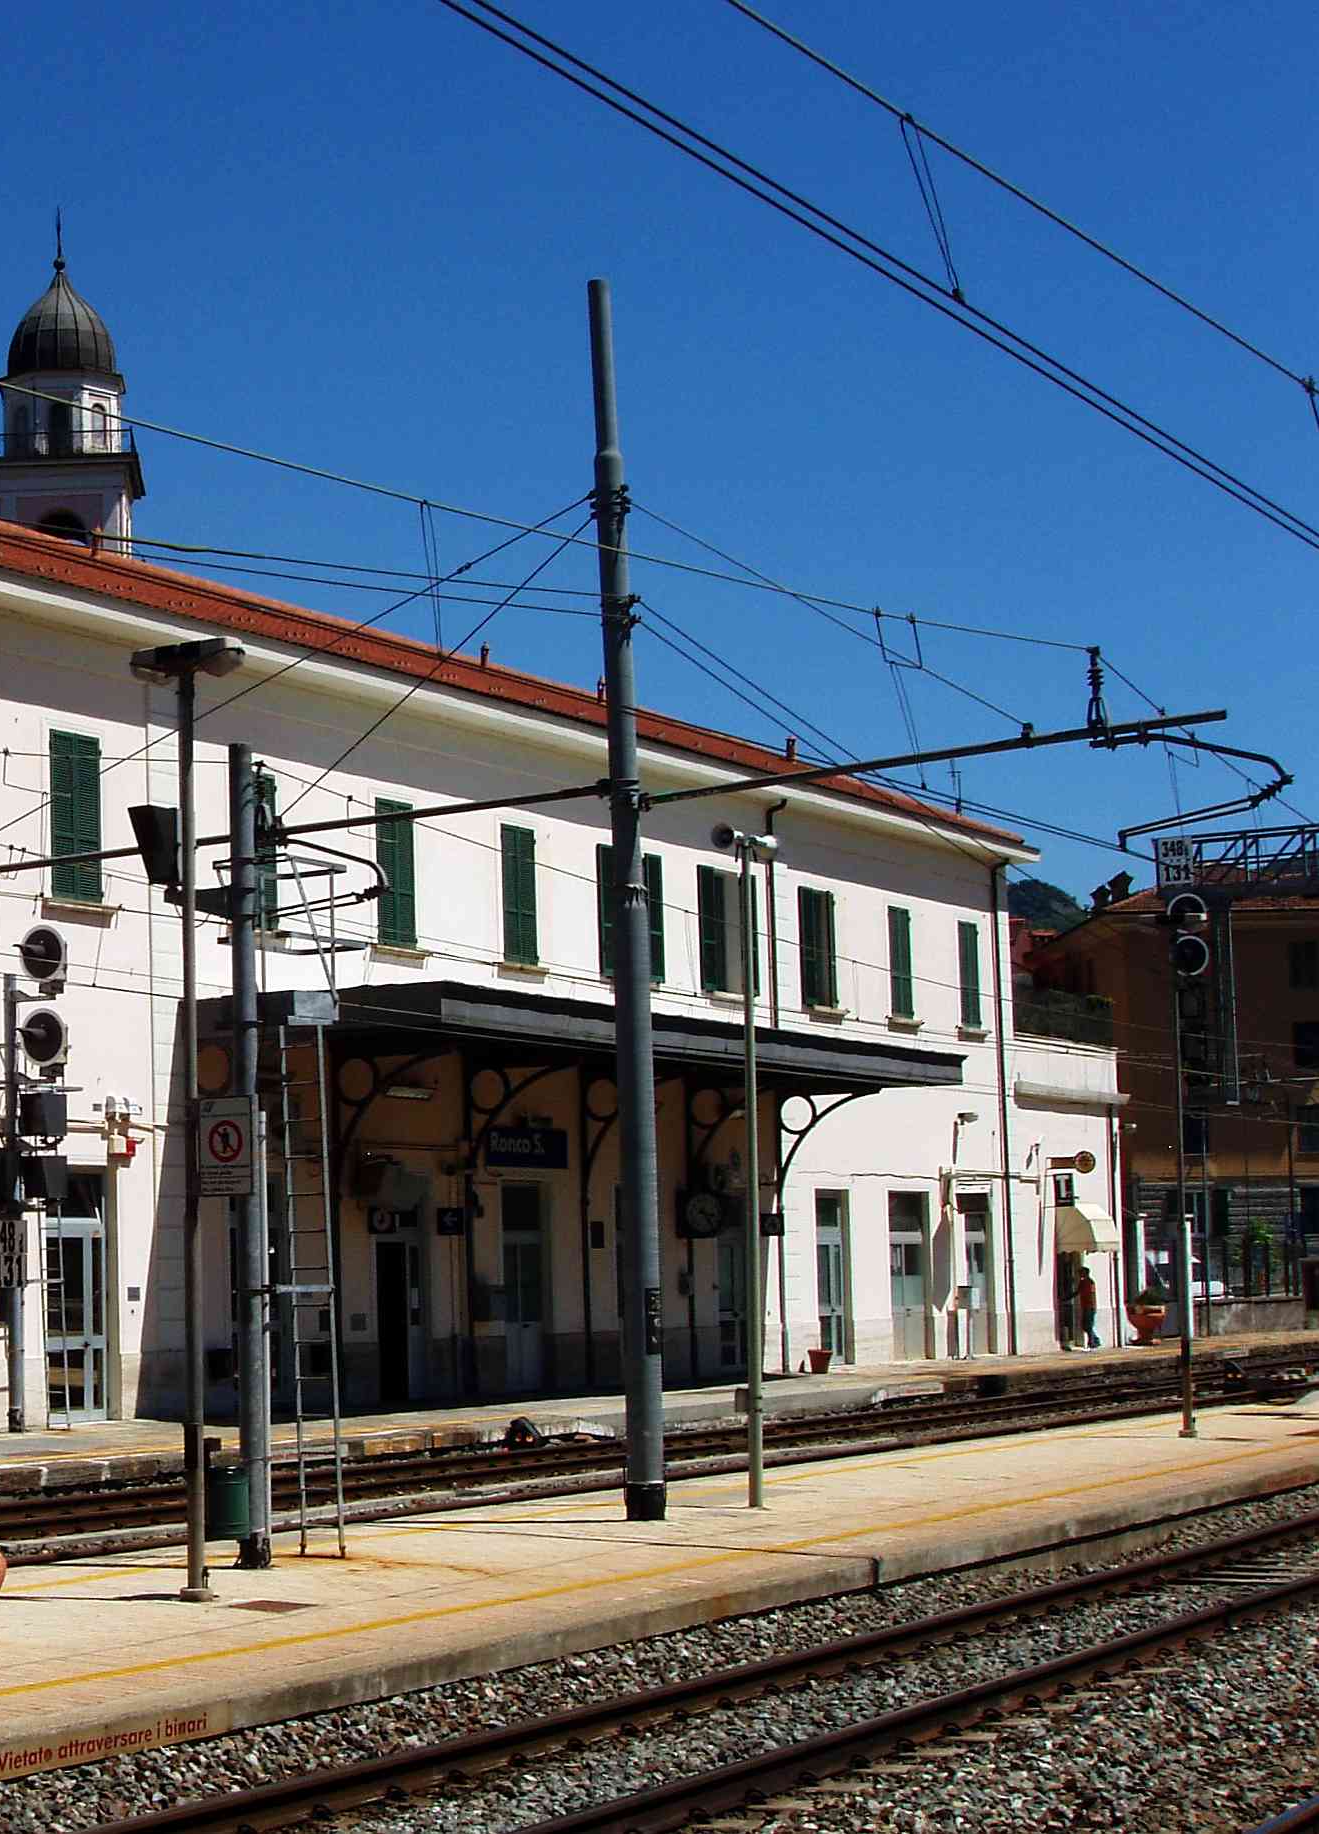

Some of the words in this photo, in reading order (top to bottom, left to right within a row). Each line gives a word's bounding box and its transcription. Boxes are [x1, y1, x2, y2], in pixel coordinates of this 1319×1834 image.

[1162, 840, 1183, 857] 348
[489, 1130, 530, 1154] Ronco
[57, 1728, 153, 1760] attraversare
[156, 1720, 162, 1740] i
[164, 1713, 207, 1738] binari
